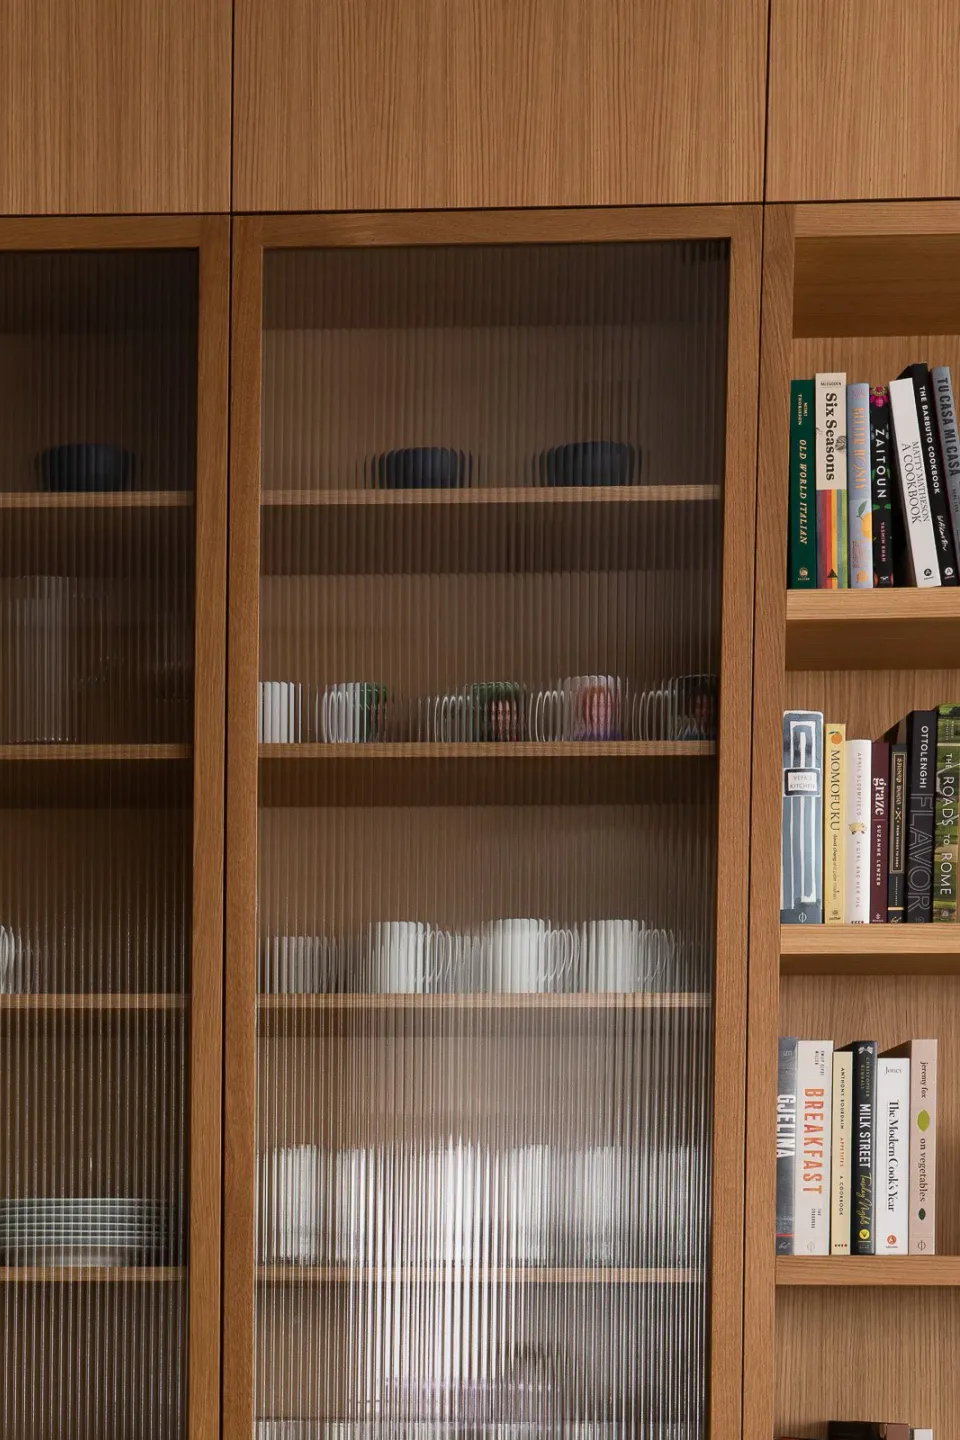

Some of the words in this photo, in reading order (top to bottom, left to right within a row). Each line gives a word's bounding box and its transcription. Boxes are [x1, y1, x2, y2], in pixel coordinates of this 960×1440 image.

[919, 386, 927, 402] THE
[937, 378, 949, 393] TU
[826, 392, 838, 417] Six
[940, 395, 954, 426] CASA
[922, 404, 933, 444] BARBUTO
[944, 429, 957, 444] MI
[826, 420, 838, 481] Seasons
[875, 428, 887, 498] ZAITOUN
[902, 443, 911, 452] A
[912, 441, 923, 472] MATTY
[946, 446, 960, 477] CASA
[928, 446, 940, 494] COOKBOOK
[904, 455, 921, 524] COOKBOOK
[916, 473, 930, 522] MATHESON
[800, 502, 808, 545] ITALIAN
[920, 726, 929, 788] OTTOLENGHI
[945, 753, 953, 769] THE
[830, 750, 840, 831] MOMOFUKU
[873, 778, 887, 816] graze
[942, 776, 955, 826] ROADS
[908, 794, 934, 913] FLAVOR
[943, 834, 950, 845] TO
[940, 853, 953, 895] ROME
[885, 1066, 902, 1074] Jones
[920, 1062, 929, 1086] jeremy
[776, 1095, 797, 1158] GJELINA
[860, 1104, 871, 1128] MILK
[889, 1099, 899, 1118] The
[803, 1089, 824, 1194] BREAKFAST
[859, 1132, 871, 1168] STREET
[889, 1120, 898, 1157] Modern
[920, 1138, 926, 1150] on
[888, 1158, 899, 1190] Cook's
[918, 1152, 928, 1202] vegetables
[888, 1191, 898, 1212] Year
